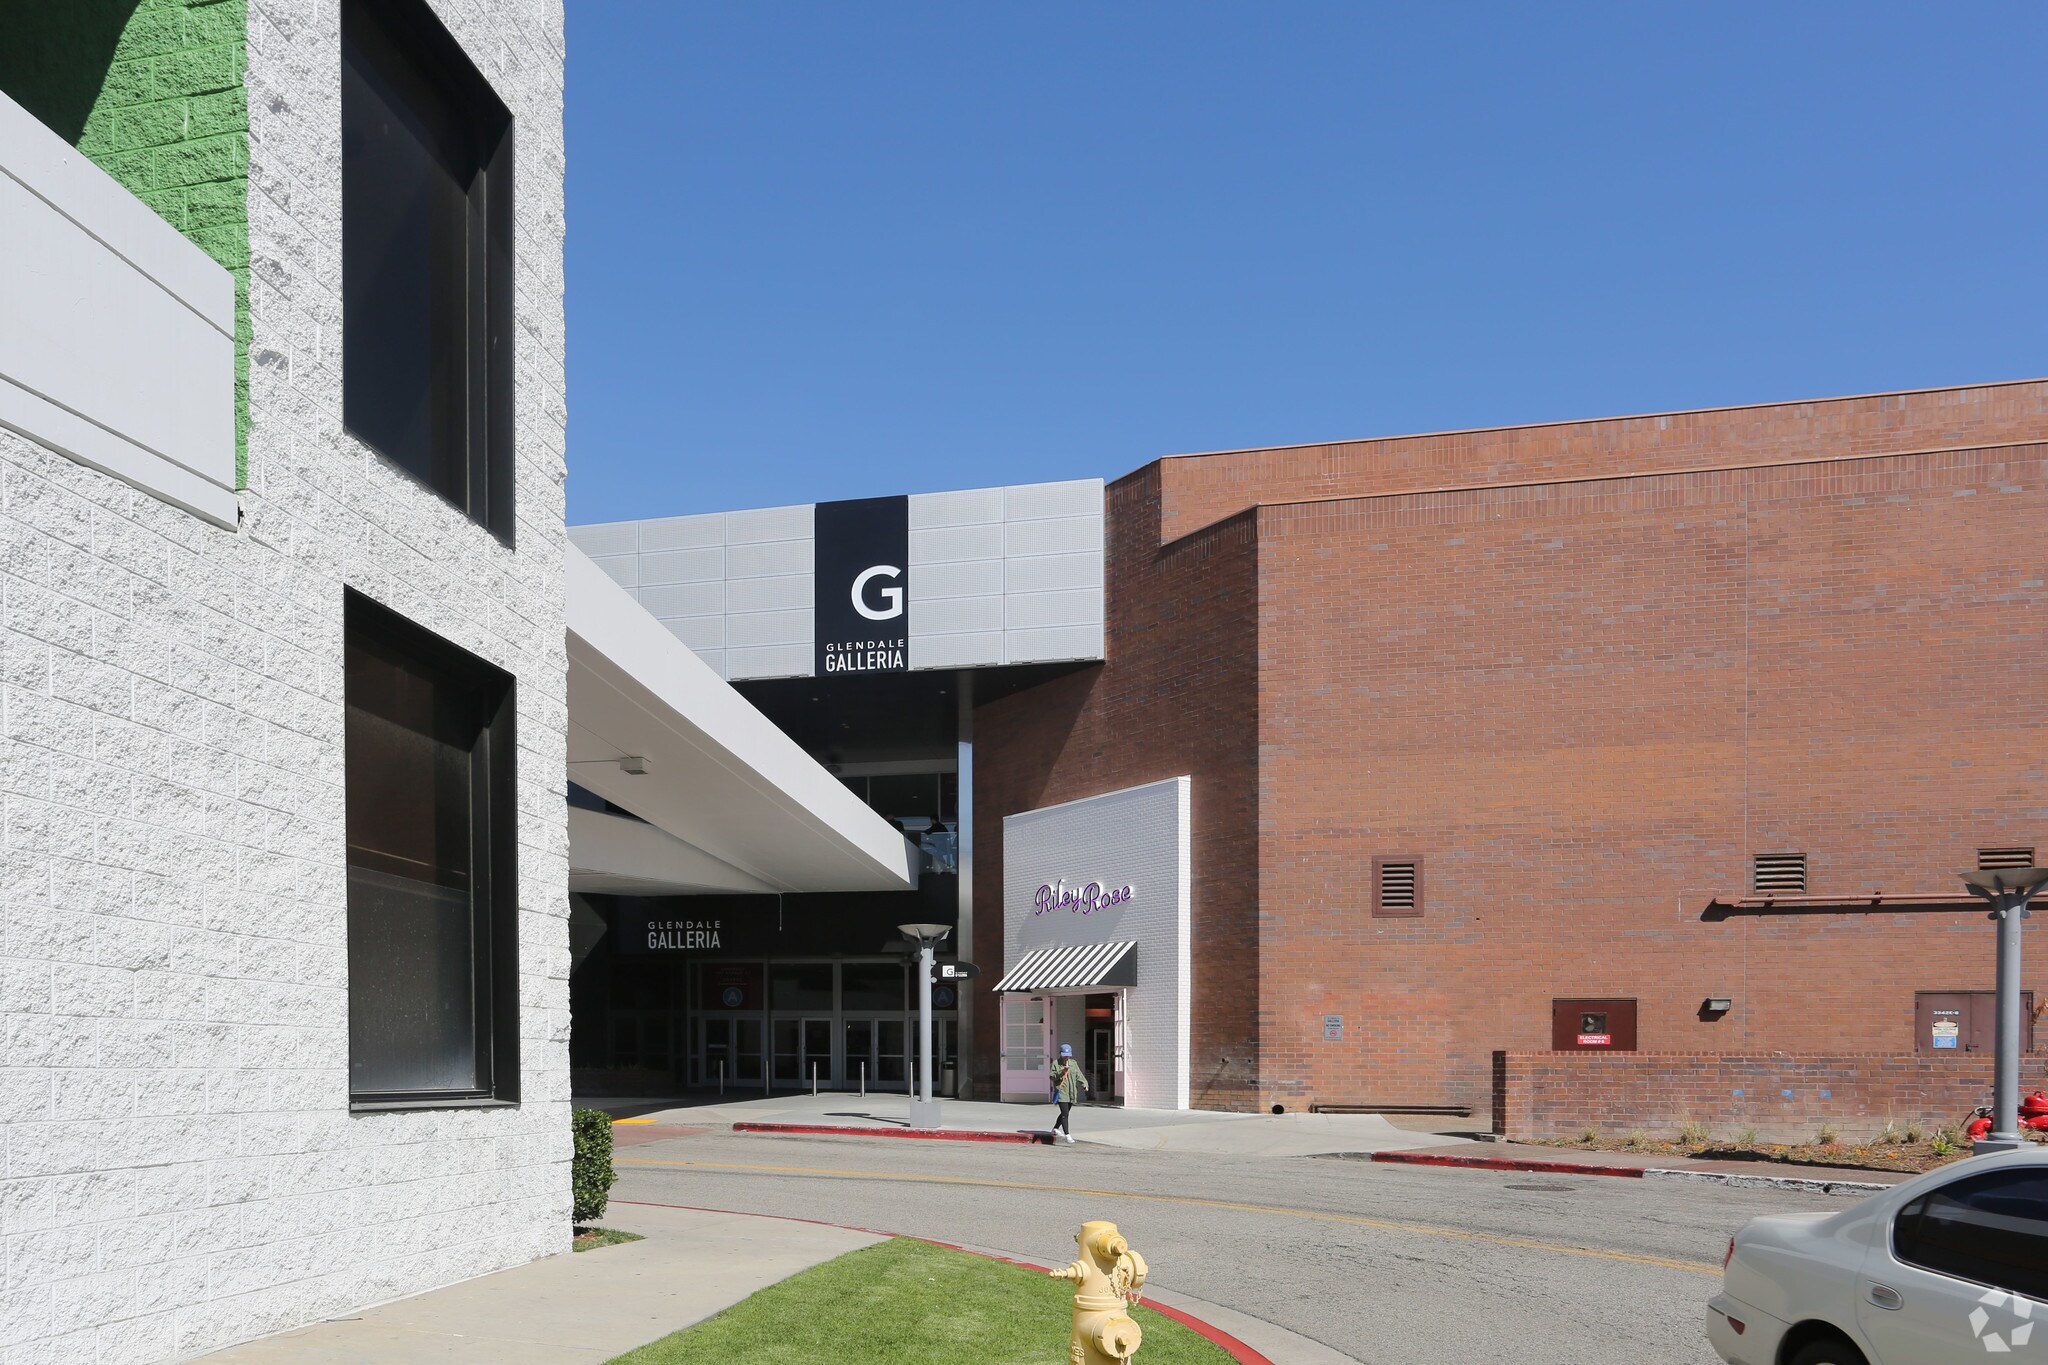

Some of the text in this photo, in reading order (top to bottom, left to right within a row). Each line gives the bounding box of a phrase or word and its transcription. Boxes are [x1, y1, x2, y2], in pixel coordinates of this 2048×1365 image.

[851, 564, 903, 621] G
[826, 639, 904, 652] GLENDALE
[825, 650, 904, 672] GALLERIA
[1034, 879, 1134, 916] Riley Rose
[647, 920, 721, 930] GLENDALE
[647, 930, 721, 949] GALLERIA
